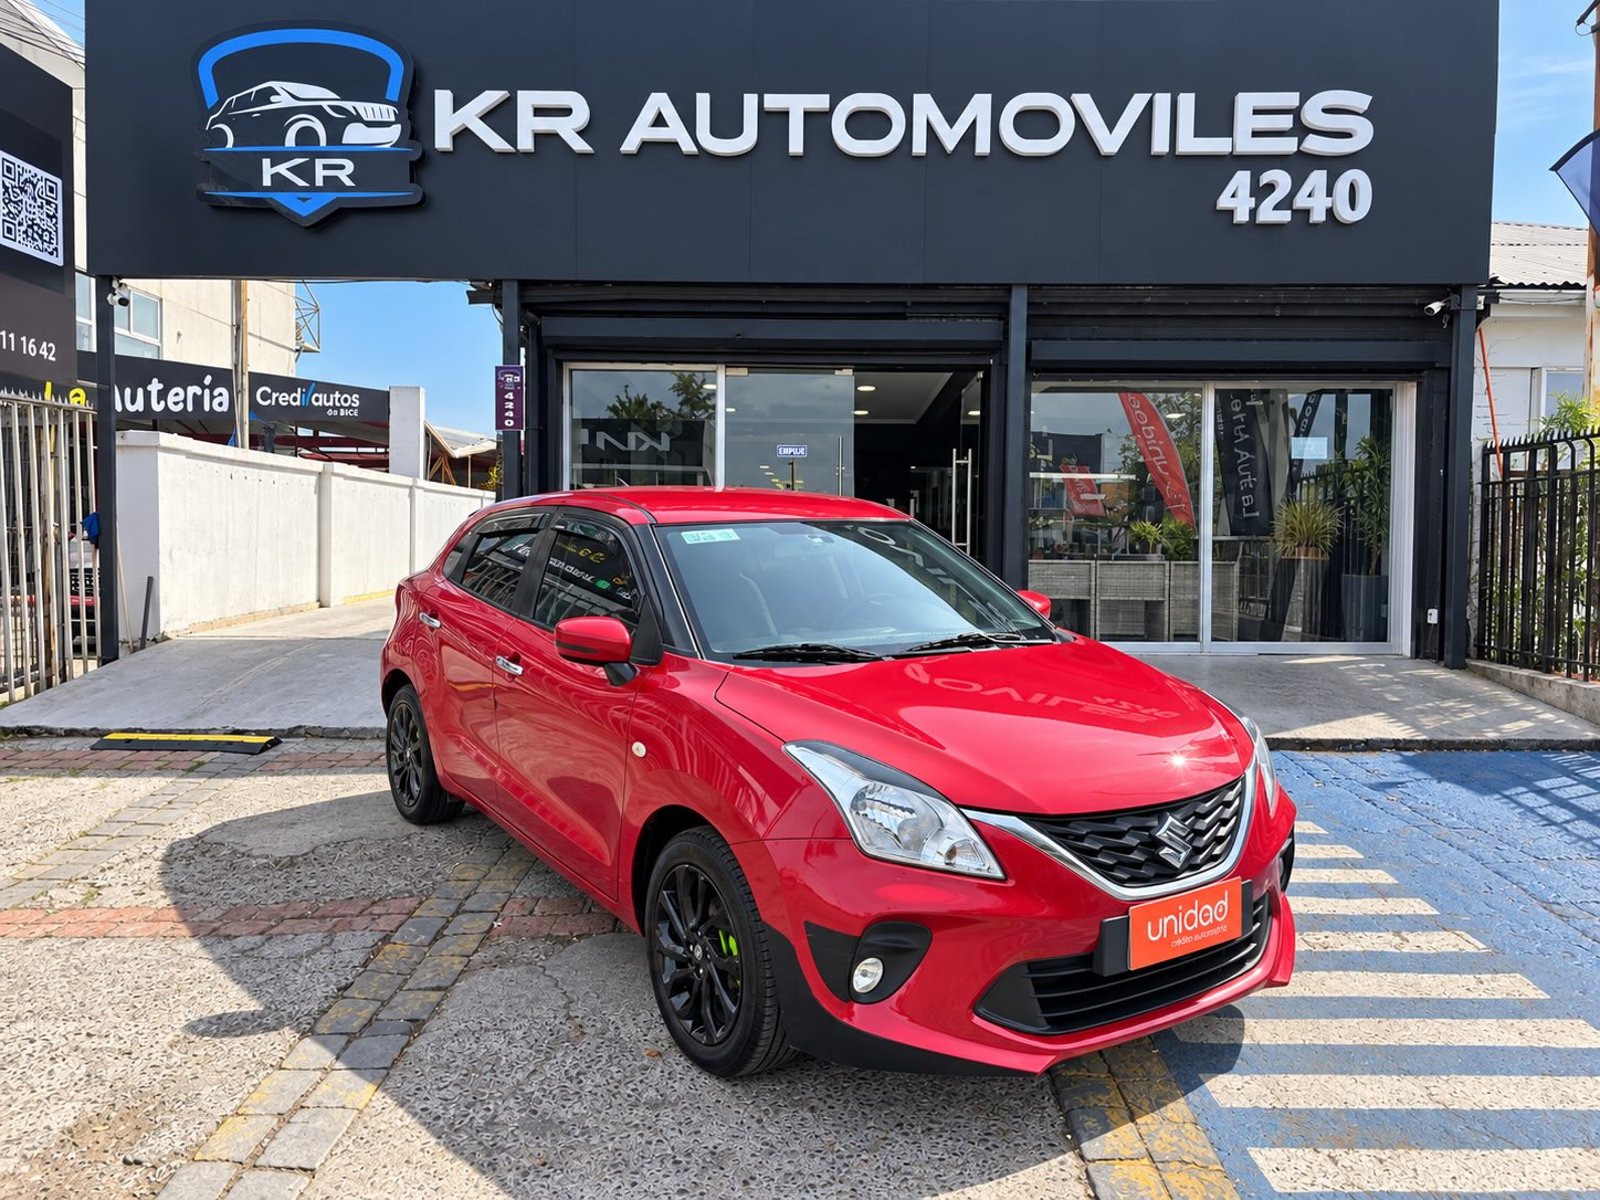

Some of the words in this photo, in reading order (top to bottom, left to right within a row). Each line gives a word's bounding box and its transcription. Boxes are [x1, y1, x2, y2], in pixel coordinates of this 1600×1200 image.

[434, 89, 595, 154] KR
[619, 89, 1375, 157] AUTOMOVILES
[262, 157, 356, 187] KR
[1216, 168, 1373, 224] 4240
[20, 336, 37, 357] 16
[39, 341, 56, 362] 42
[115, 374, 230, 413] utería
[1147, 890, 1229, 941] unidad
